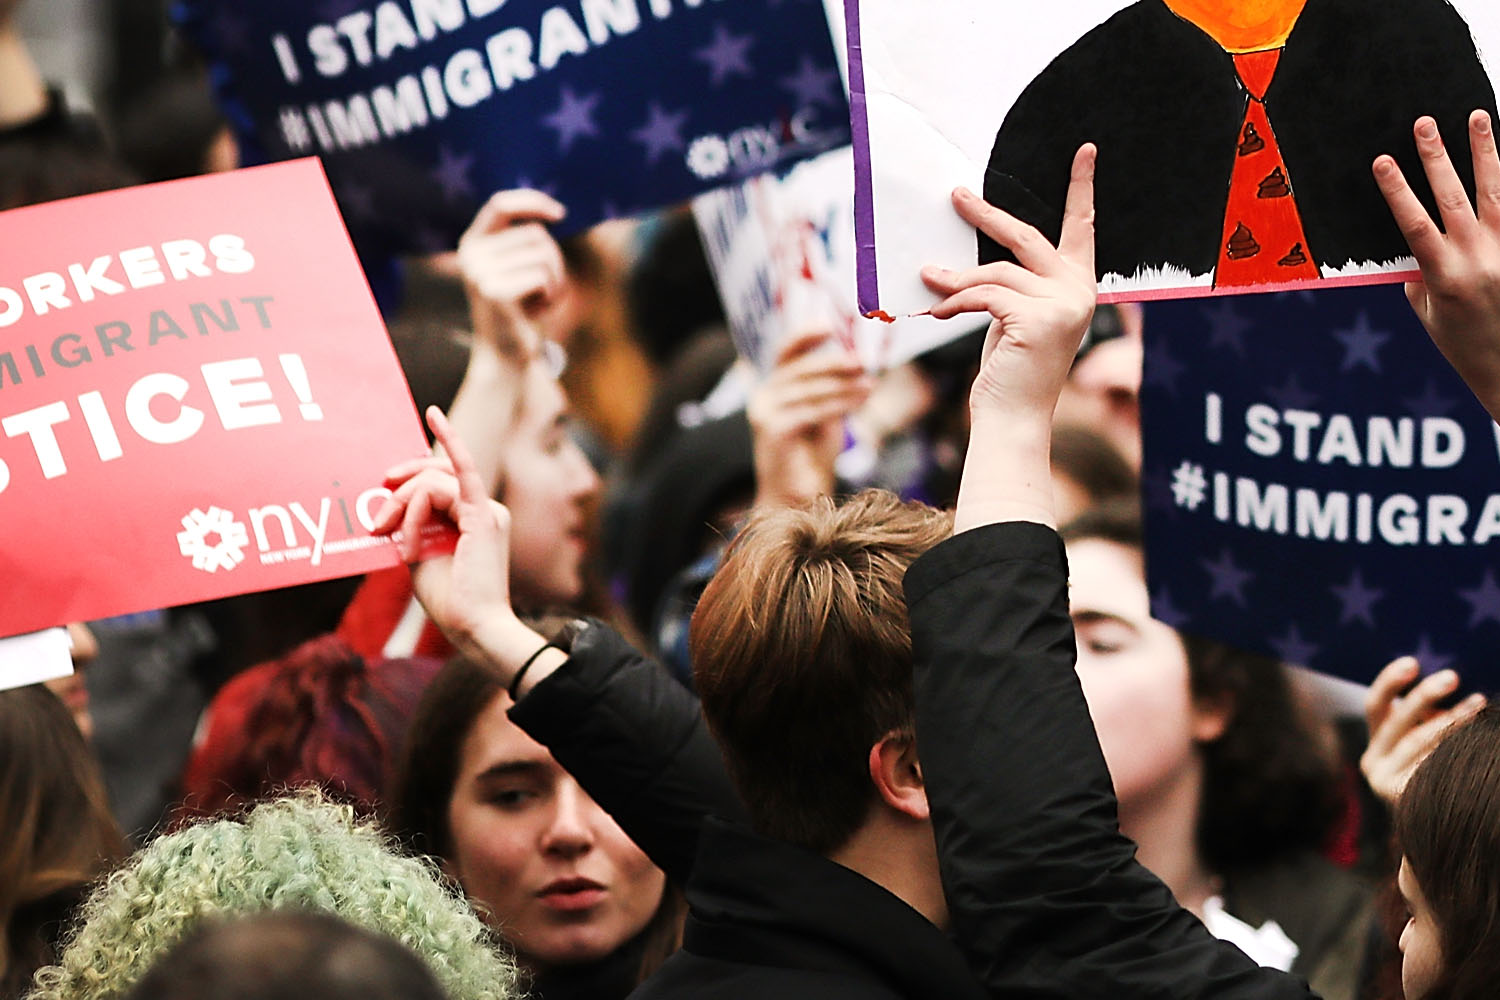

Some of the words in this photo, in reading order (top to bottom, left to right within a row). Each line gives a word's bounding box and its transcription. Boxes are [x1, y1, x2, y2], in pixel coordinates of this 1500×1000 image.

[272, 33, 300, 83] I
[0, 352, 325, 494] TICE!
[1204, 393, 1222, 445] I
[1245, 403, 1466, 469] STAND
